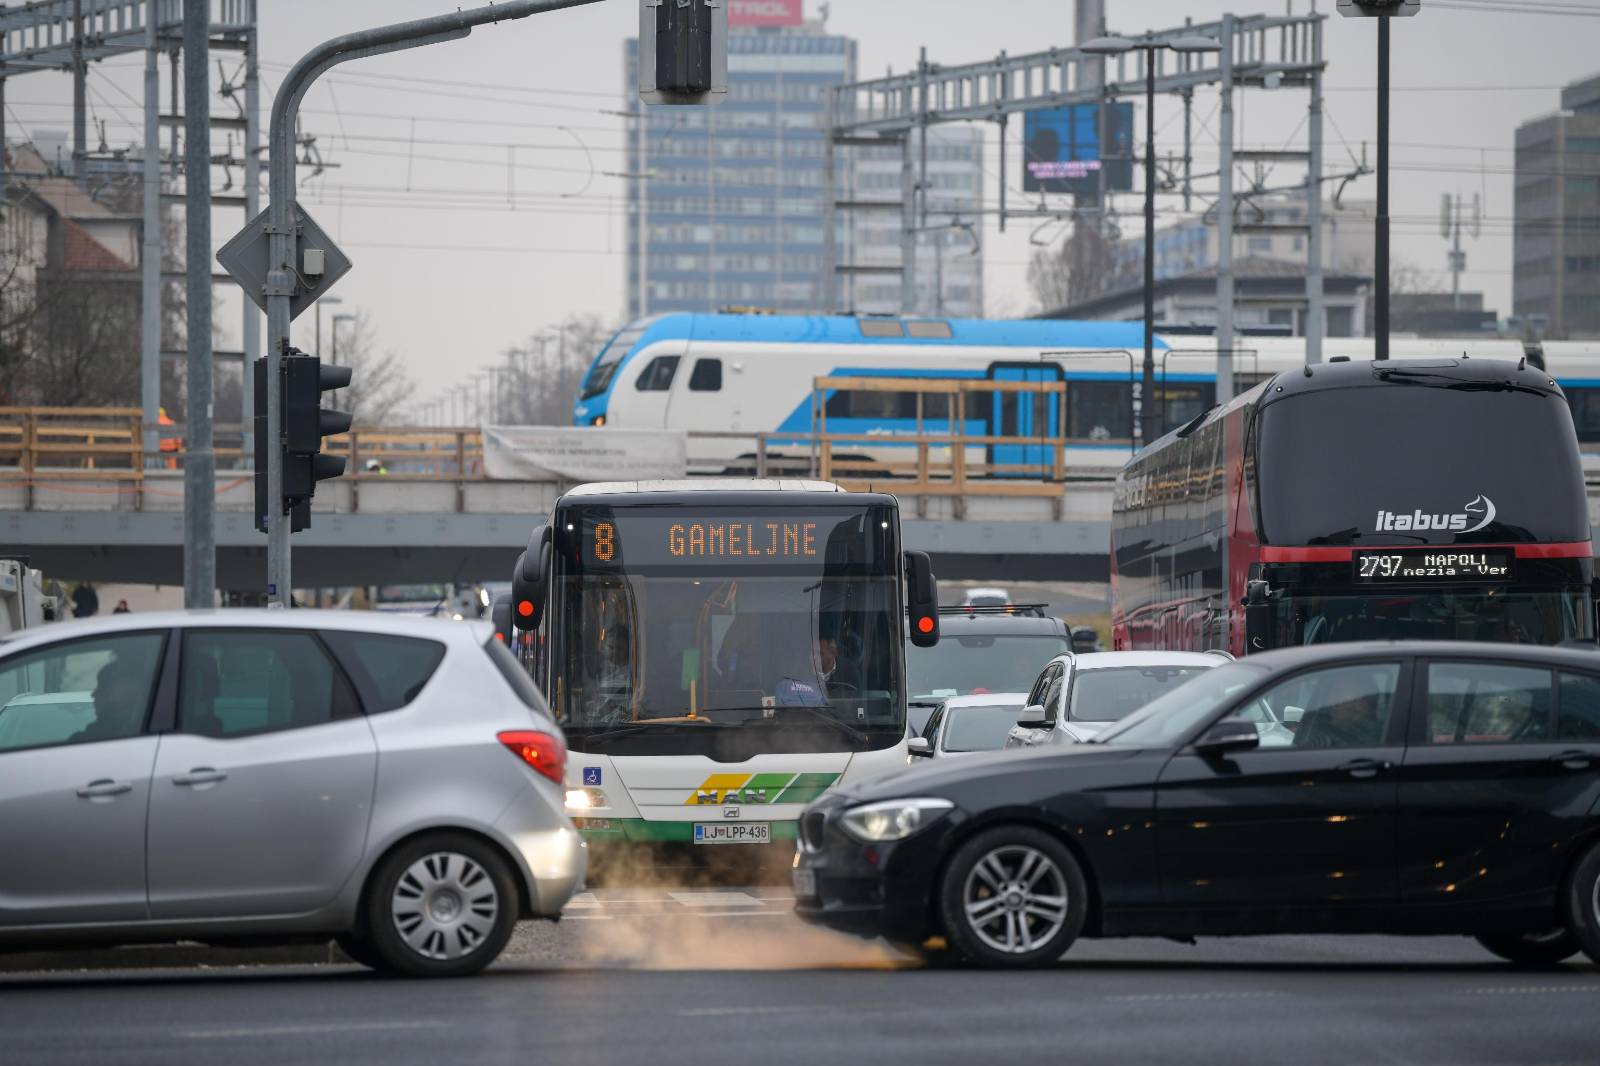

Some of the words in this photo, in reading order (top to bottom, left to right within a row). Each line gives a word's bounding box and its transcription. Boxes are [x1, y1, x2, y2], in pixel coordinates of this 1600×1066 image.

[728, 1, 792, 17] TROL
[1375, 509, 1468, 532] itabus
[594, 522, 615, 562] 8
[669, 522, 817, 556] GAMELJNE
[1359, 555, 1403, 577] 2797
[1424, 554, 1486, 566] NAPOLI
[1403, 566, 1456, 576] nezia
[1478, 565, 1508, 575] Ver
[697, 788, 766, 804] MAN
[704, 826, 718, 839] LJ
[726, 826, 767, 839] LPP-436
